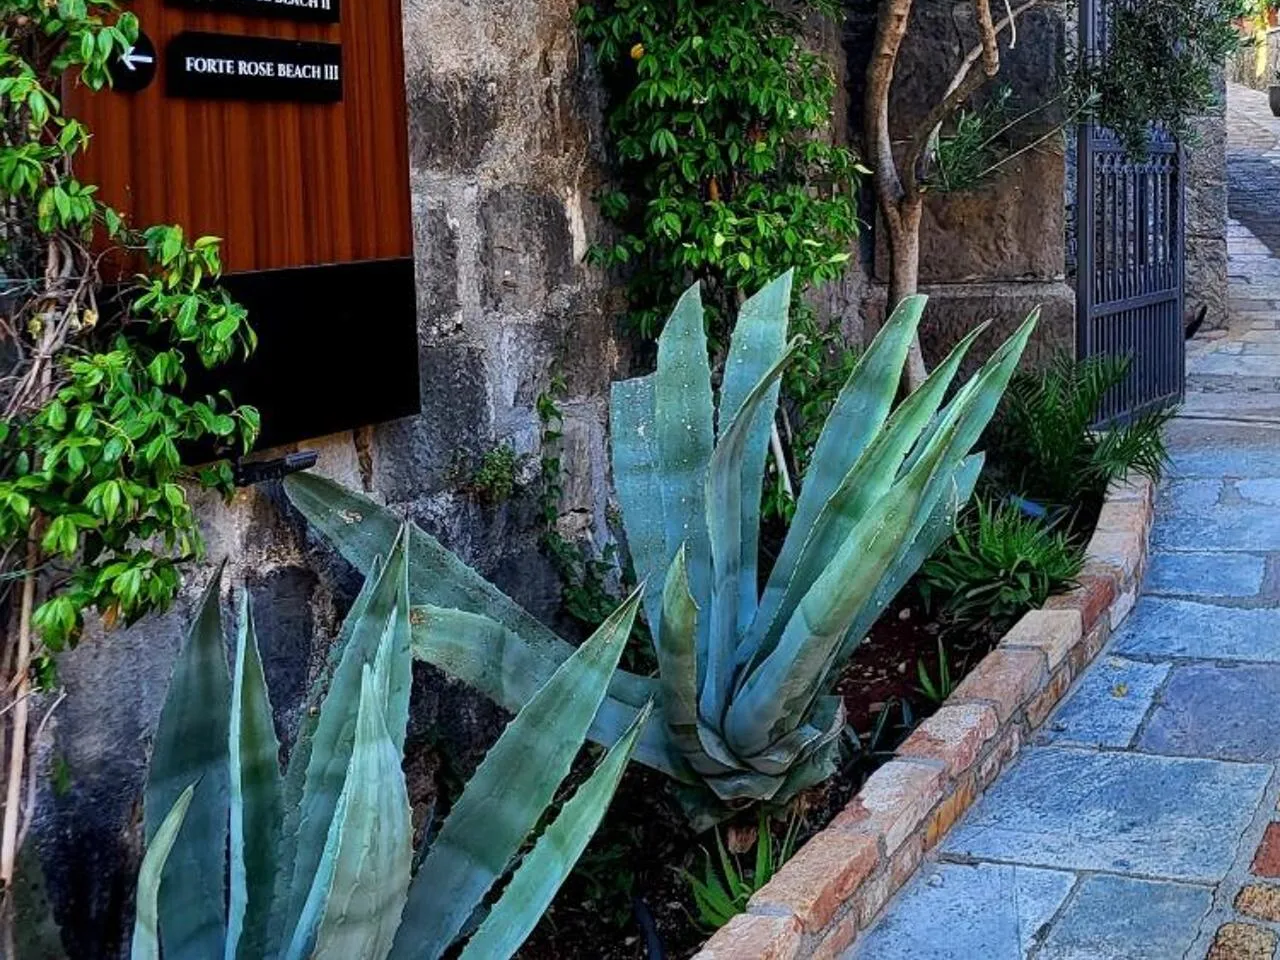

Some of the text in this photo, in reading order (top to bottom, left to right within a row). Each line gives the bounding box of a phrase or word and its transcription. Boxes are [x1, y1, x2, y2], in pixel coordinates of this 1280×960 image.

[185, 57, 339, 81] FORTE ROSE BEACH III
